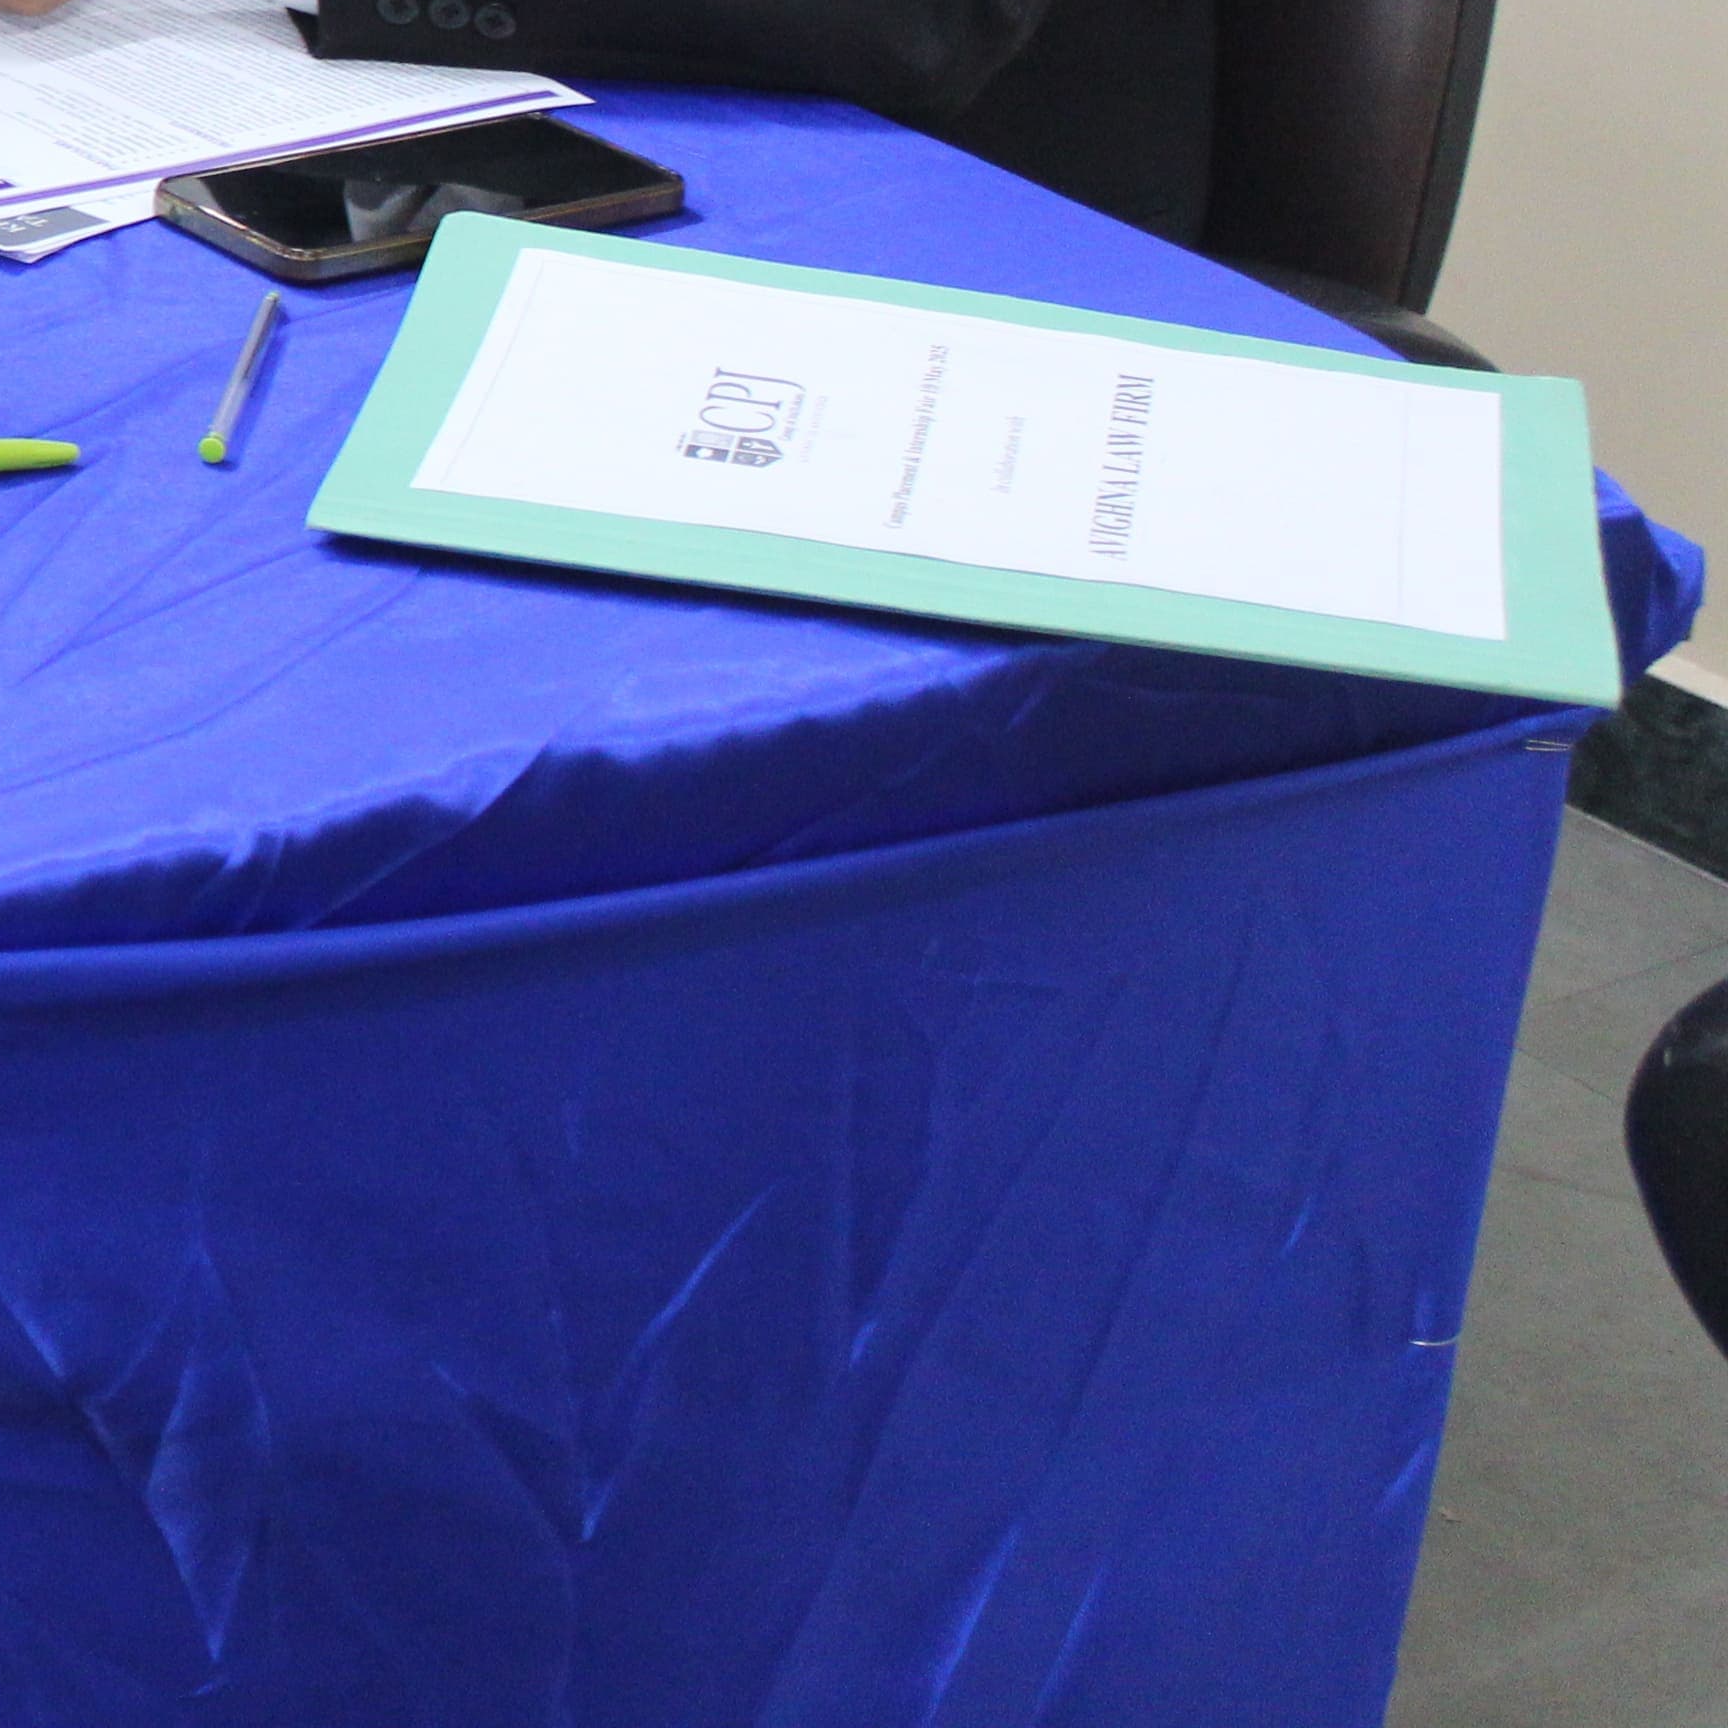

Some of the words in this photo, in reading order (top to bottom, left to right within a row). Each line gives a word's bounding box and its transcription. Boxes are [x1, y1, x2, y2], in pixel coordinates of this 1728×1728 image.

[699, 366, 807, 433] CPJ
[1111, 373, 1155, 425] FIRM
[1102, 426, 1145, 475] LAW
[1088, 479, 1139, 561] AVIGHNA
